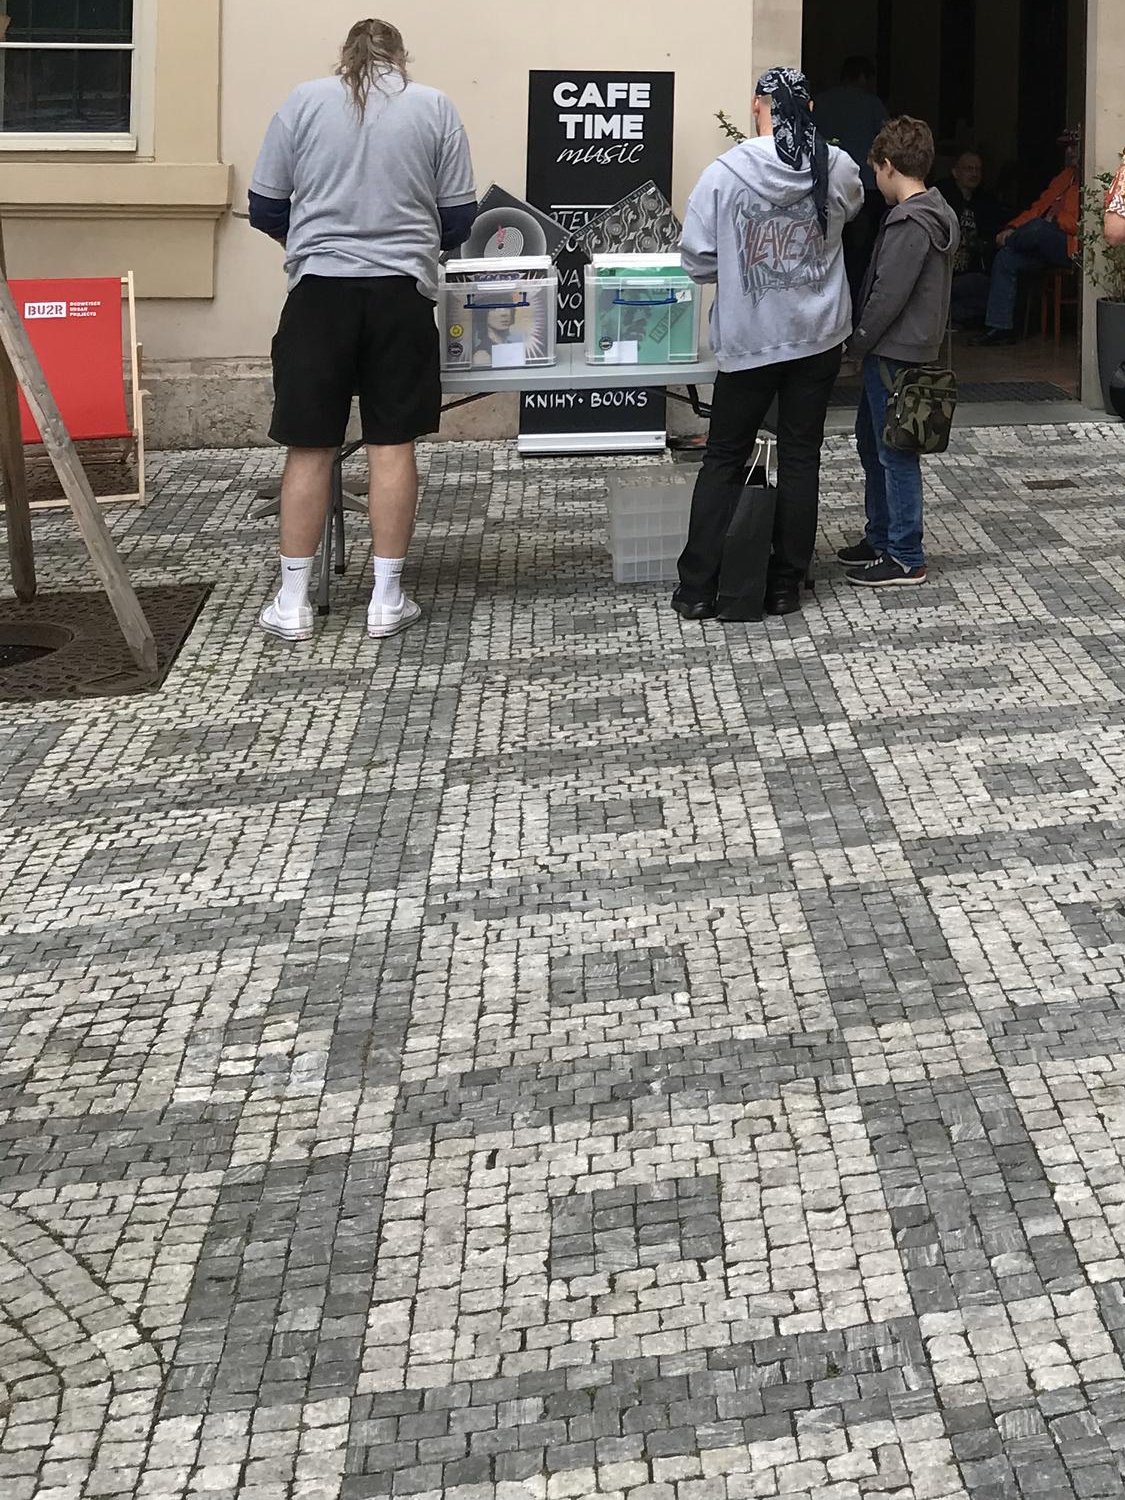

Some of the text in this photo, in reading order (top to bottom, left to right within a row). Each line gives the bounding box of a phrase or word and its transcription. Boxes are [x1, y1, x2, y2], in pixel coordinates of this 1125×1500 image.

[553, 82, 651, 108] CAFE
[559, 114, 644, 140] TIME
[556, 143, 645, 165] music
[28, 304, 63, 316] BU2R
[590, 391, 648, 408] BOOKS
